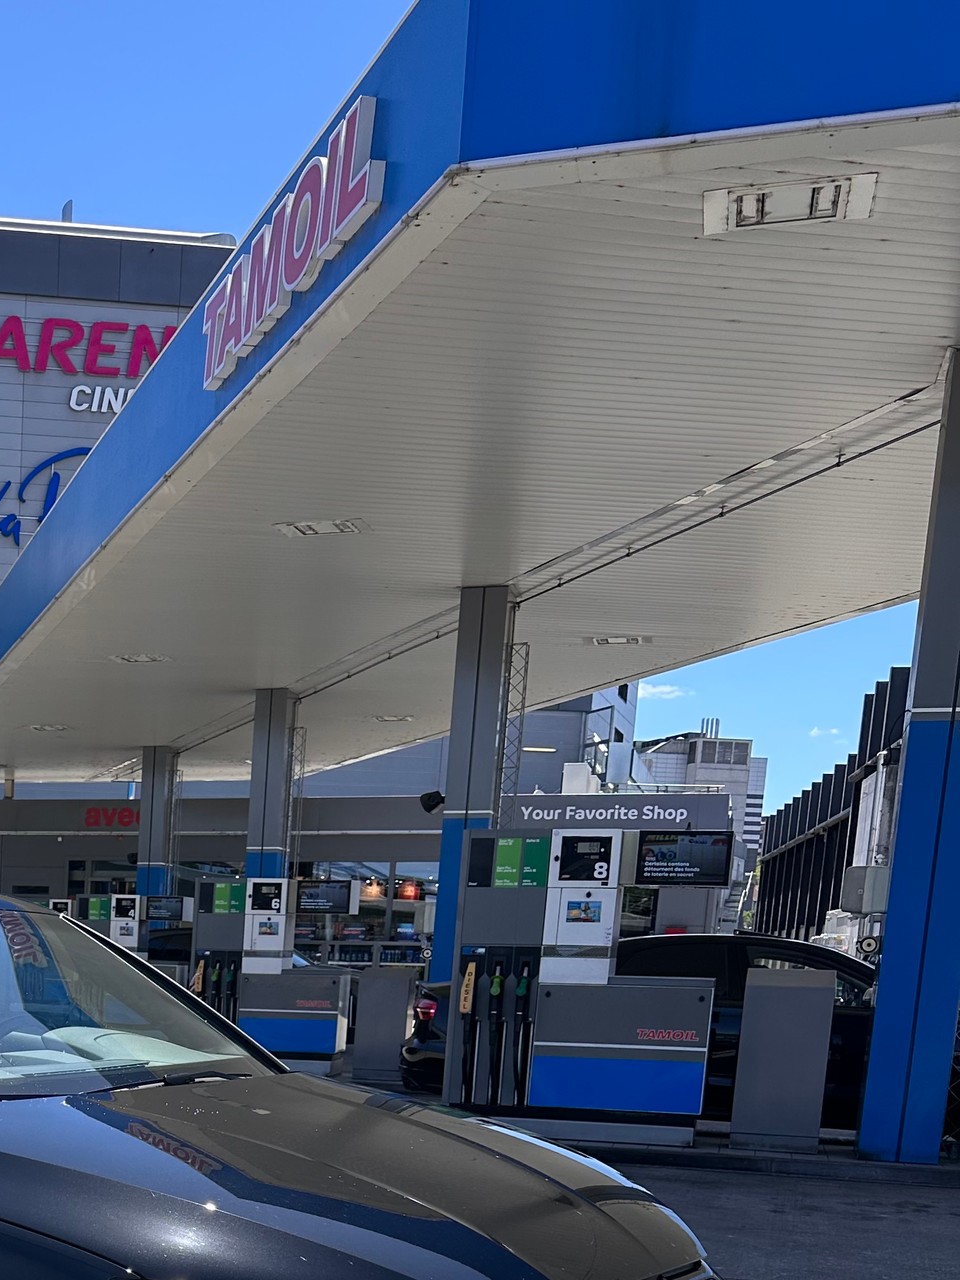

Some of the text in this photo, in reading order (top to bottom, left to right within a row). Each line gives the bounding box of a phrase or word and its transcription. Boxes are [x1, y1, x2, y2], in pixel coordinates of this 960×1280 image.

[203, 95, 382, 390] TAMOIL
[84, 806, 140, 828] ave
[521, 804, 688, 823] Your Favorite Shop
[593, 862, 608, 879] 8
[271, 898, 280, 910] 6
[128, 909, 135, 918] 4
[462, 971, 473, 1010] DIESEL
[637, 1028, 700, 1042] TAMOIL
